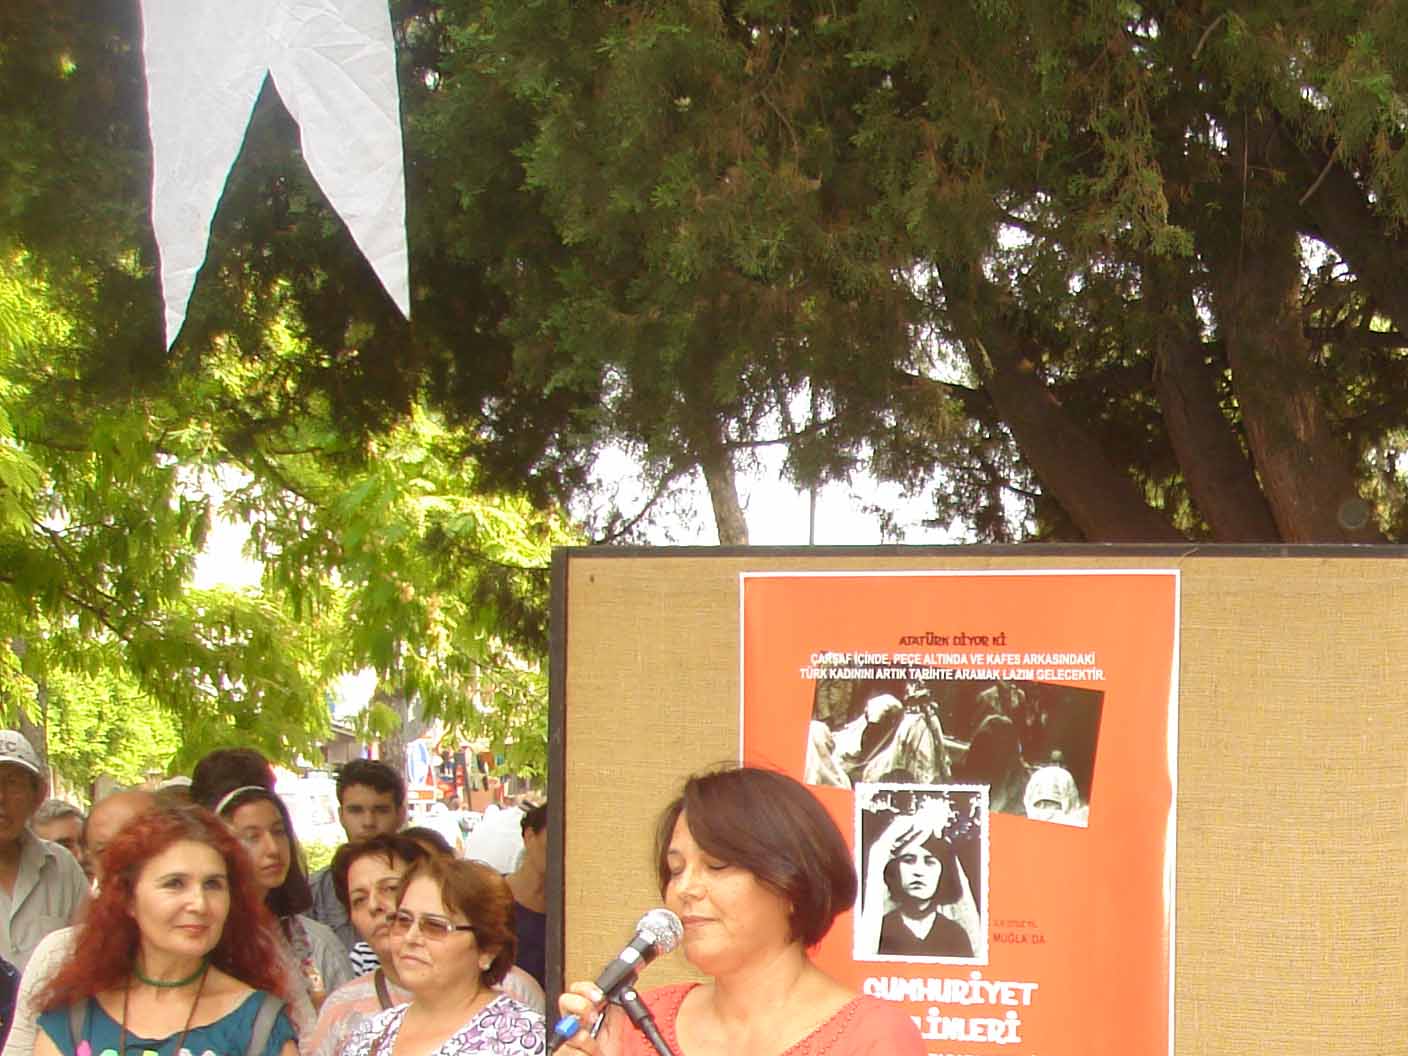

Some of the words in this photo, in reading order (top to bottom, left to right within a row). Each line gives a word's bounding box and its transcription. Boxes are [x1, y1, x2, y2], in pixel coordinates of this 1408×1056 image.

[899, 632, 949, 646] ATATÜRK
[953, 632, 989, 646] DİYOR
[992, 632, 1007, 646] Kİ
[811, 652, 853, 666] ÇARŞAF
[854, 651, 891, 666] İÇİNDE,
[894, 652, 921, 667] PEÇE
[923, 653, 967, 666] ALTINDA
[970, 653, 984, 664] VE
[986, 653, 1021, 665] KAFES
[1023, 651, 1096, 665] ARKASINDAKİ
[800, 667, 828, 680] TÜRK
[829, 668, 874, 680] KADININI
[875, 668, 907, 680] ARTIK
[908, 667, 953, 680] TARİHTE
[954, 668, 1000, 681] ARAMAK
[1002, 669, 1033, 680] LAZIM
[1036, 668, 1106, 681] GELECEKTİR.
[863, 970, 1039, 1006] CUMHURİYET
